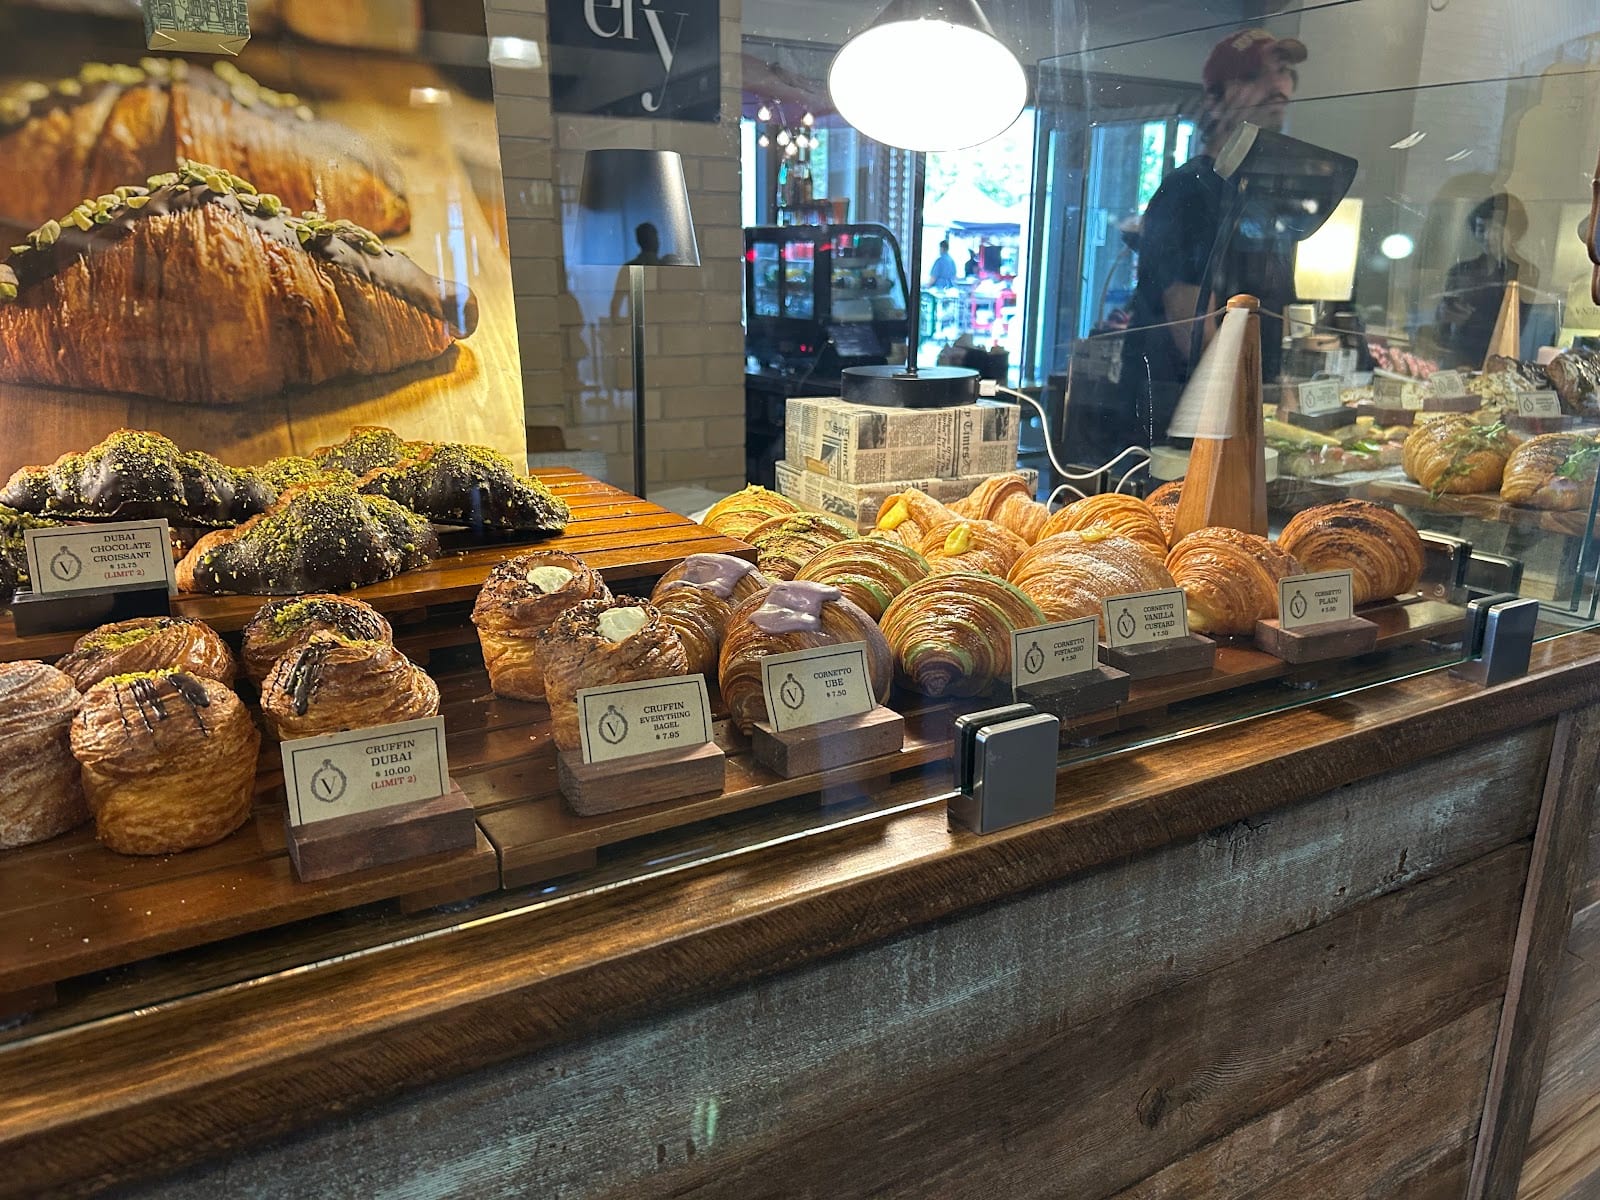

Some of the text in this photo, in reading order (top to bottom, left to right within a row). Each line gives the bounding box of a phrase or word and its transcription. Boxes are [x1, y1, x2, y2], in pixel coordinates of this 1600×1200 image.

[104, 533, 136, 542] DUBAI
[90, 541, 151, 553] CHOCOLATE
[93, 552, 151, 562] CROISSANT
[104, 569, 145, 580] (LIMIT 2)
[1319, 597, 1338, 605] PLAIN
[1143, 604, 1173, 612] CORNETTO
[1144, 611, 1174, 621] VANILLA
[1145, 621, 1175, 630] CUSTARD
[1053, 638, 1085, 649] CORNETTO
[813, 668, 852, 679] CORNETTO
[825, 678, 844, 688] UBE
[832, 689, 847, 697] 7.50
[643, 701, 684, 714] CRUFFIN
[640, 710, 691, 724] EVERYTHING
[653, 721, 680, 731] BAGEL
[662, 731, 680, 740] 7.95
[365, 739, 415, 755] CRUFFIN
[371, 751, 413, 767] DUBAI
[384, 765, 411, 777] 10.00
[371, 774, 416, 791] (LIMIT 2)
